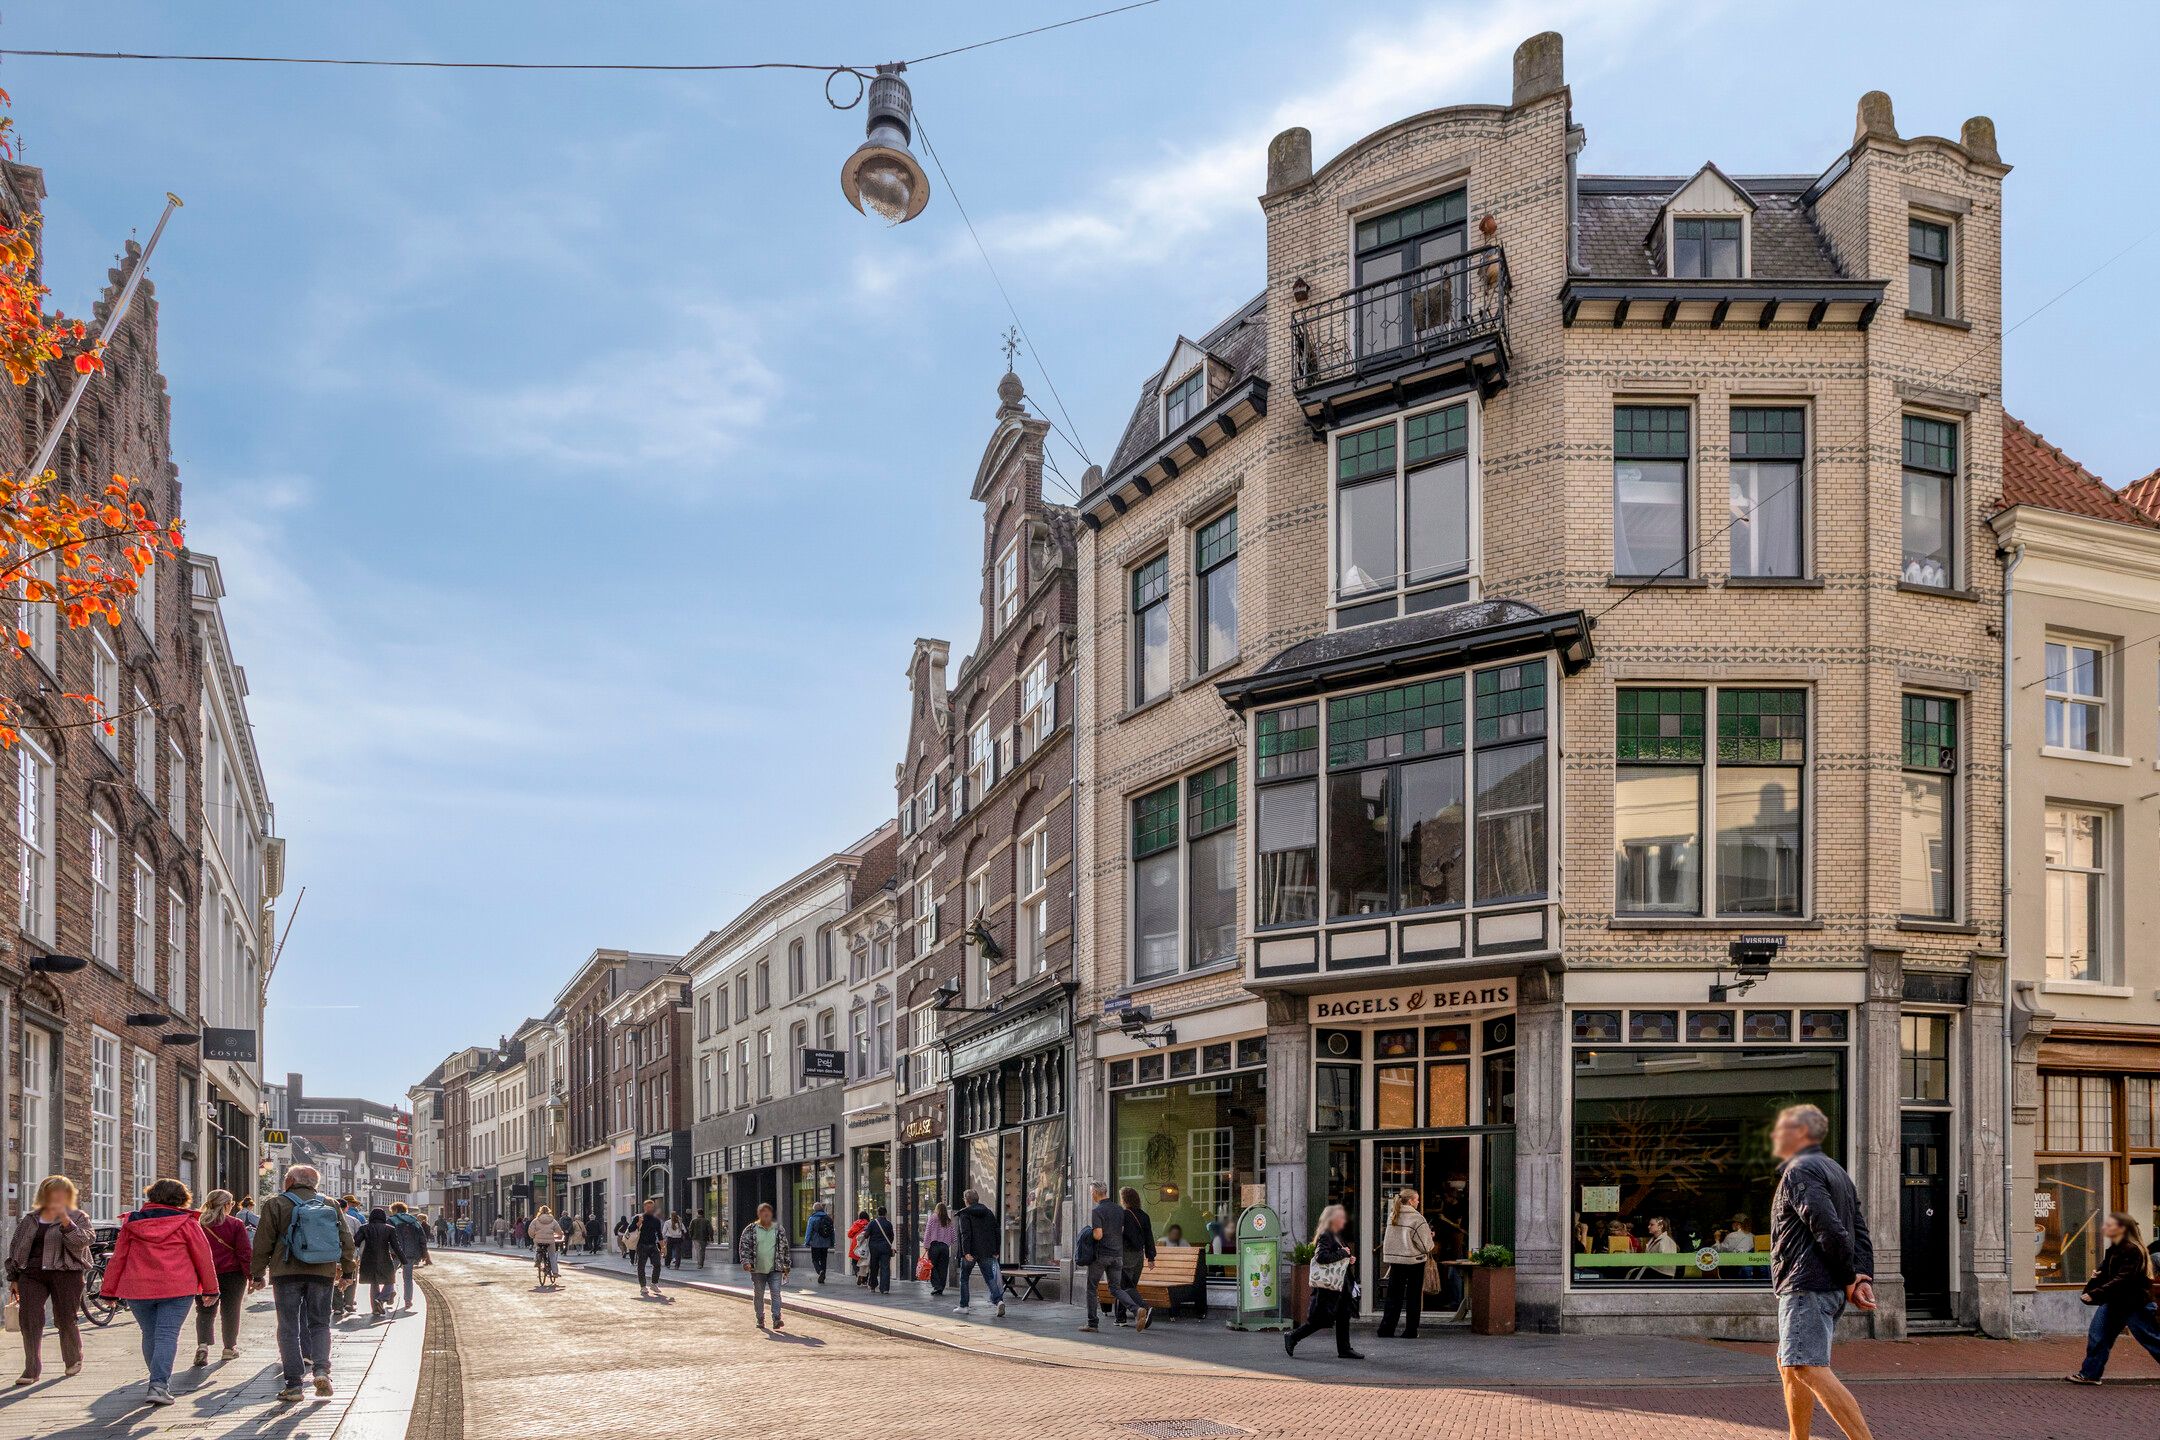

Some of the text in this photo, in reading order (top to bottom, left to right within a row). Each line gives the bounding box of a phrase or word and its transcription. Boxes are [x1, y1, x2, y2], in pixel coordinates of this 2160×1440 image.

[1317, 986, 1509, 1018] BAGELS & BEANS
[210, 1050, 252, 1058] COSTES
[745, 1113, 756, 1137] JD
[396, 1112, 410, 1170] HEMA
[2034, 1193, 2051, 1201] VOOR
[2034, 1209, 2049, 1217] CINO
